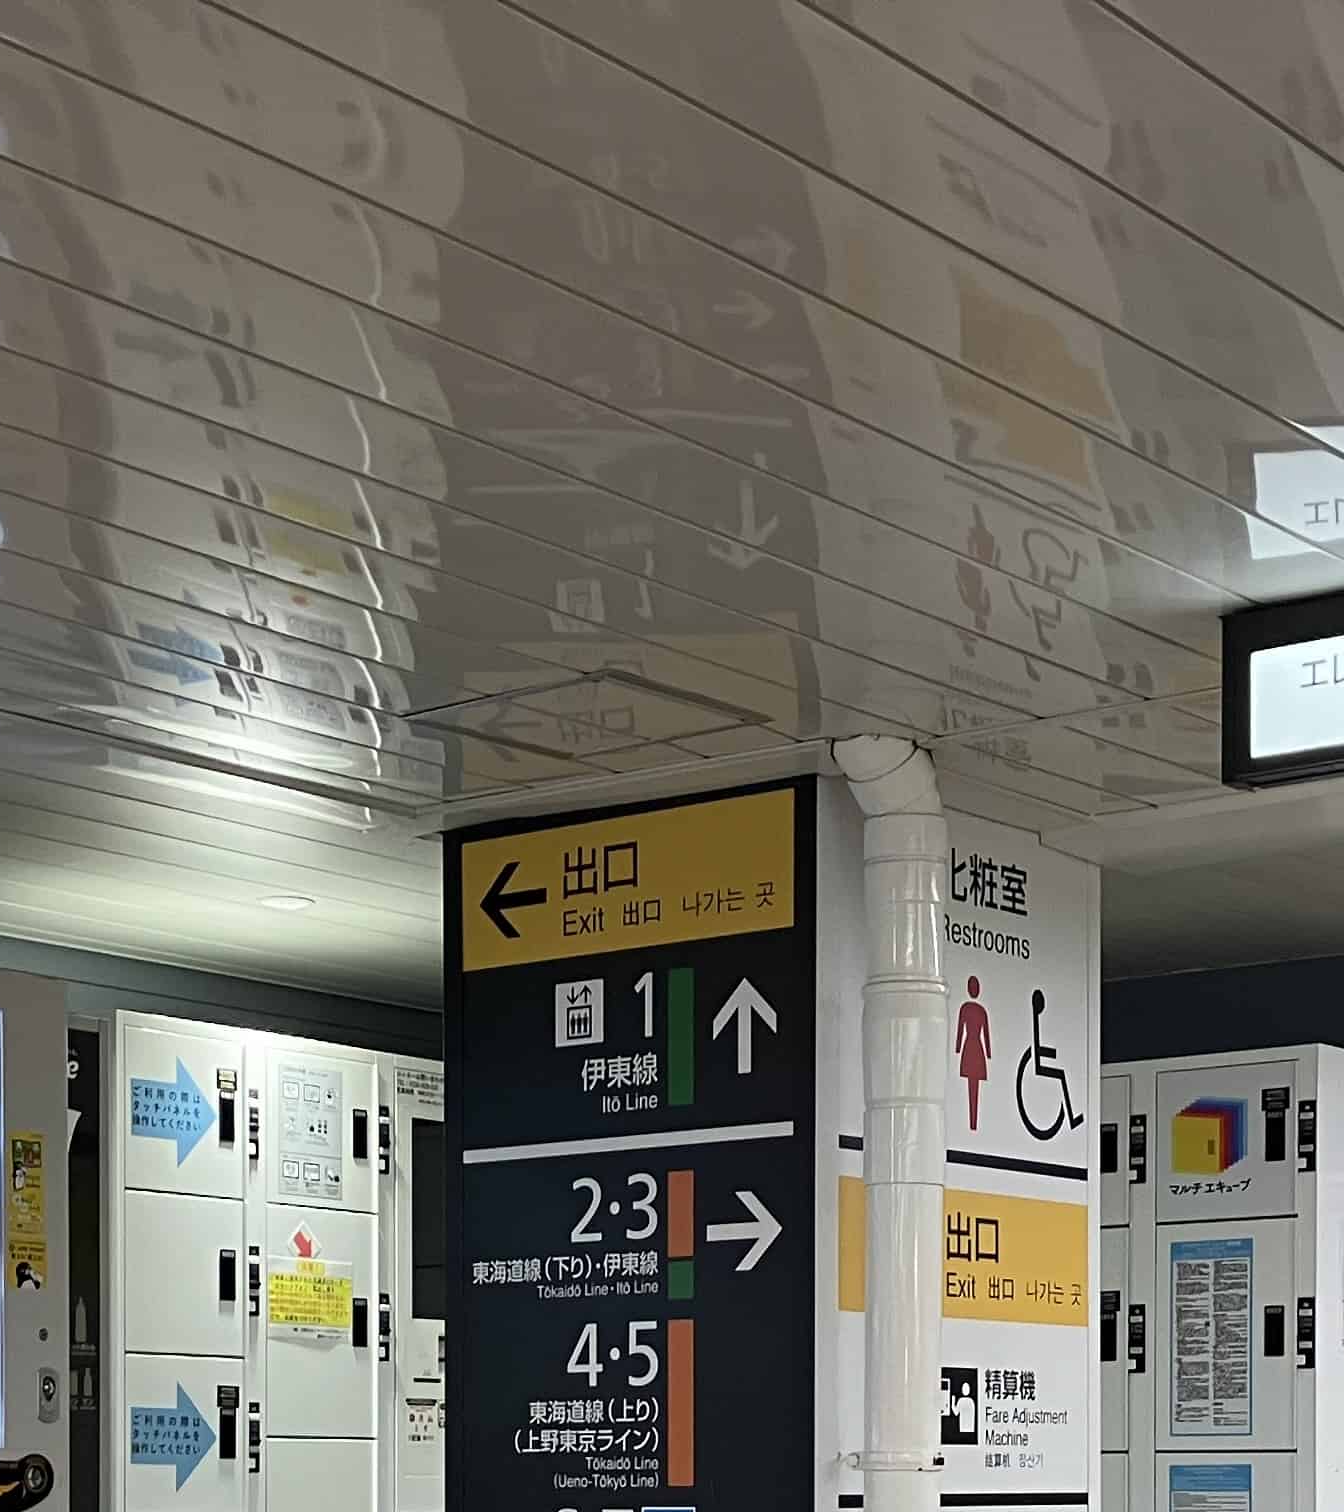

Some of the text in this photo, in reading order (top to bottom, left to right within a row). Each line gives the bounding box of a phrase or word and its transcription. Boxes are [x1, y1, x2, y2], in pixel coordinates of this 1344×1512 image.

[562, 841, 640, 899] 出口
[562, 881, 776, 937] Exit 出口 나가는 곳
[633, 970, 654, 1039] 1
[581, 1052, 659, 1092] 伊東線
[625, 1093, 659, 1111] Line
[945, 1211, 1000, 1264] 出口
[633, 1279, 659, 1294] Line
[945, 1272, 1083, 1307] Exit 出口 나가는 곳
[984, 1368, 1036, 1401] 精算機
[985, 1406, 1068, 1428] Fare Adjustment
[985, 1429, 1029, 1447] Machine
[585, 1456, 659, 1471] Tōkaidō Line
[630, 1471, 659, 1489] Line)
